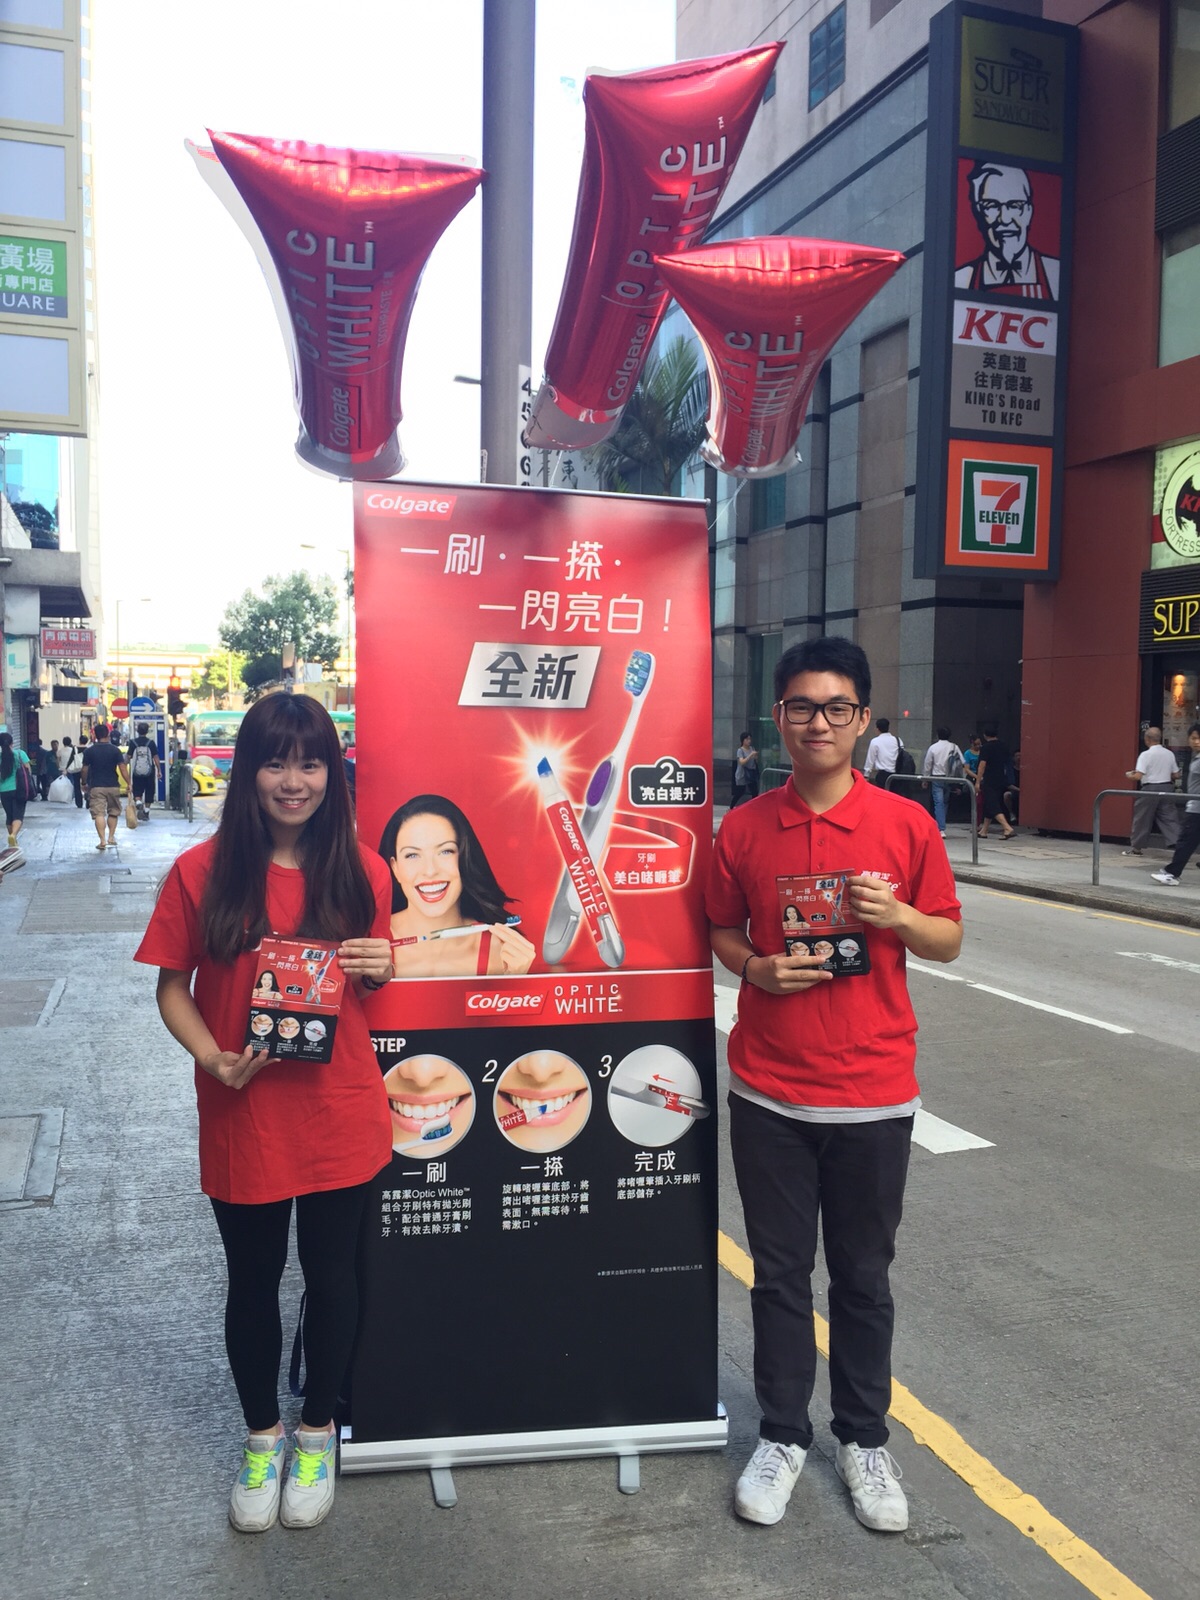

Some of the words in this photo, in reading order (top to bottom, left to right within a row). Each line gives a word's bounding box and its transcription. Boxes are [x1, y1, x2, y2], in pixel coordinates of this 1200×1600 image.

[974, 62, 1050, 105] SUPER
[615, 144, 688, 299] OPTIC
[0, 274, 54, 293] 專門店
[286, 229, 322, 360] OPTIC
[325, 236, 375, 368] WHITE
[958, 307, 1049, 349] KFC
[607, 323, 651, 402] Colgate
[982, 351, 1027, 373] 英皇道
[974, 371, 1033, 393] 往肯德基
[329, 386, 357, 447] Colgate
[965, 391, 1005, 407] KING'S
[1010, 396, 1040, 412] Road
[982, 409, 996, 424] TO
[1001, 412, 1023, 426] KFC
[741, 428, 766, 465] Colgate
[366, 492, 451, 516] Colgate
[981, 480, 1021, 545] 7
[1153, 600, 1199, 636] SUP
[481, 650, 579, 701] 全新
[558, 806, 582, 852] Colgate
[581, 856, 608, 911] OPTIC
[568, 860, 600, 917] WHITE
[467, 993, 542, 1012] Colgate
[554, 984, 619, 996] OPTIC
[554, 996, 619, 1015] WHITE
[370, 1037, 406, 1053] STEP
[481, 1058, 498, 1083] 2
[598, 1054, 612, 1078] 3
[402, 1161, 447, 1183] 一刷
[634, 1149, 676, 1172] 完成
